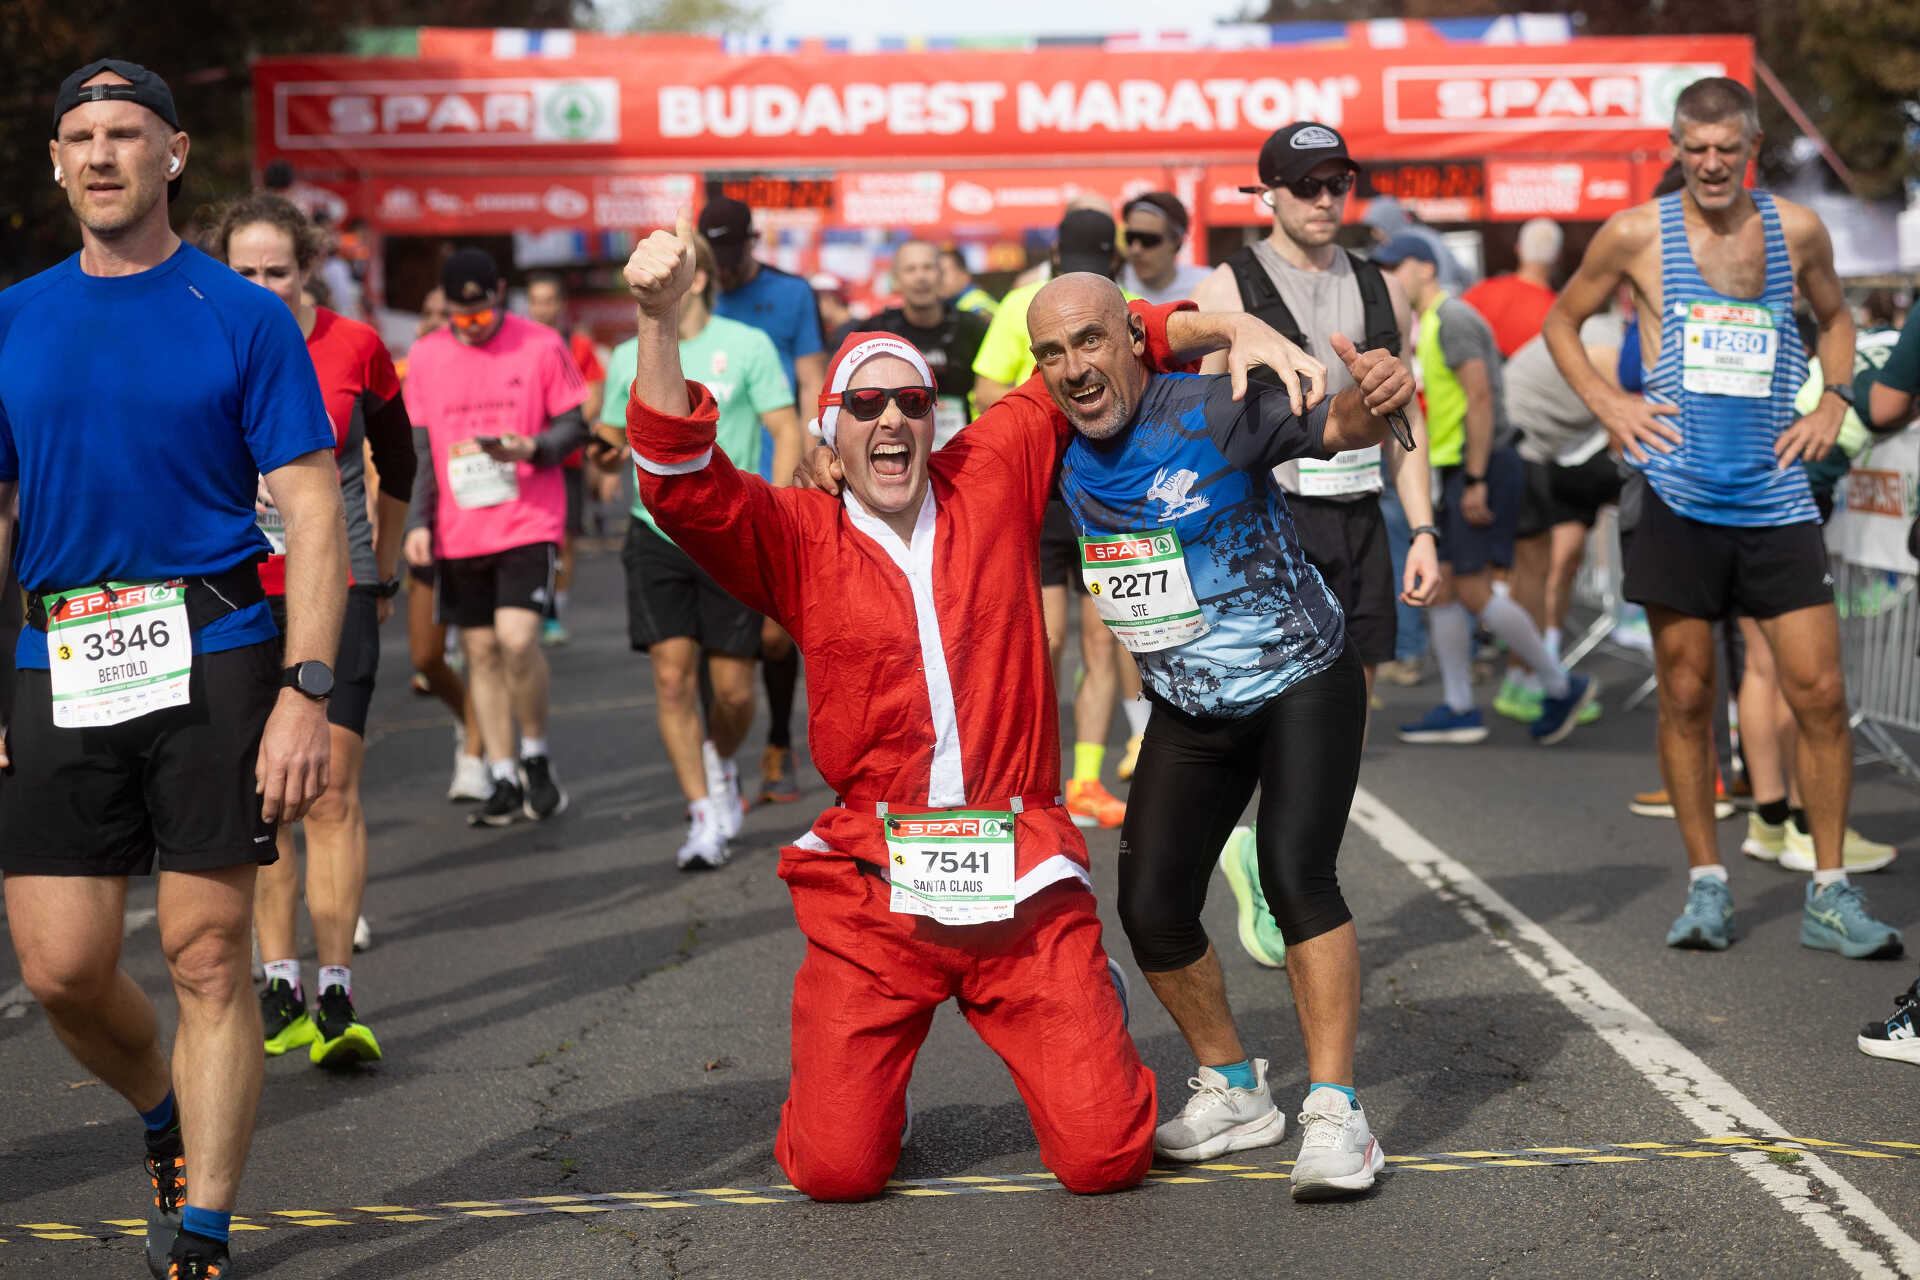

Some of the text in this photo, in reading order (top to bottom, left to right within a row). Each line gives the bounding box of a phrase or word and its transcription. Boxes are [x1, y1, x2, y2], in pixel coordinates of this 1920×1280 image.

[1437, 77, 1639, 119] SPAR
[328, 94, 529, 133] SPAR
[658, 82, 1006, 137] BUDAPEST
[1712, 330, 1763, 353] 1260
[1095, 542, 1152, 559] SPAR
[1091, 583, 1100, 595] 3
[1108, 569, 1168, 599] 2277
[1131, 604, 1149, 617] STE
[83, 620, 170, 661] 3346
[60, 646, 71, 660] 3
[98, 661, 148, 683] BERTOLD
[908, 822, 978, 834] SPAR
[894, 855, 904, 865] 4
[921, 851, 989, 873] 7541
[913, 880, 983, 893] SANTA CLAUS
